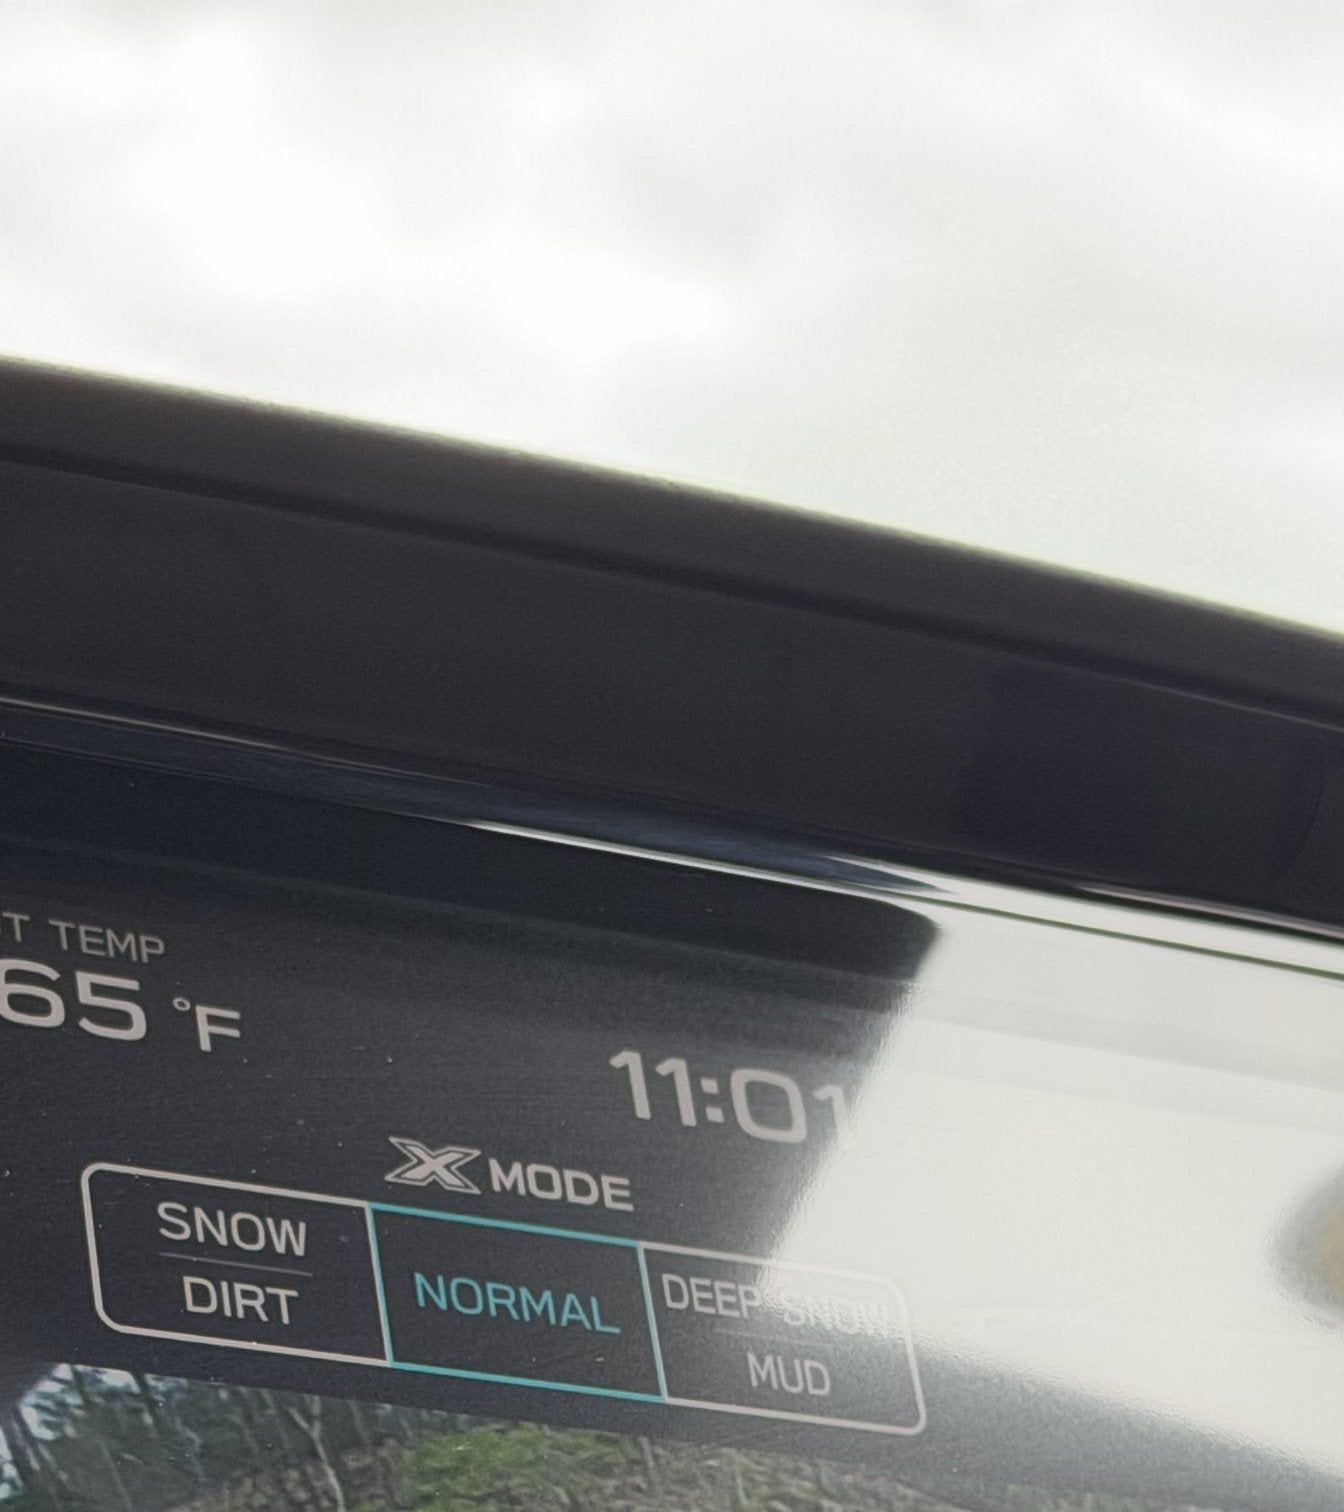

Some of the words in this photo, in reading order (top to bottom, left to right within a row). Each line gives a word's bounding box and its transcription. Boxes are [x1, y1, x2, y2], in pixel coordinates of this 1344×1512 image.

[48, 919, 165, 964] TEMP
[489, 1158, 634, 1211] MODE
[158, 1201, 308, 1257] SNOW
[182, 1274, 297, 1325] DIRT
[413, 1270, 621, 1335] NORMAL
[661, 1273, 761, 1319] DEEP
[746, 1353, 831, 1396] MUD
